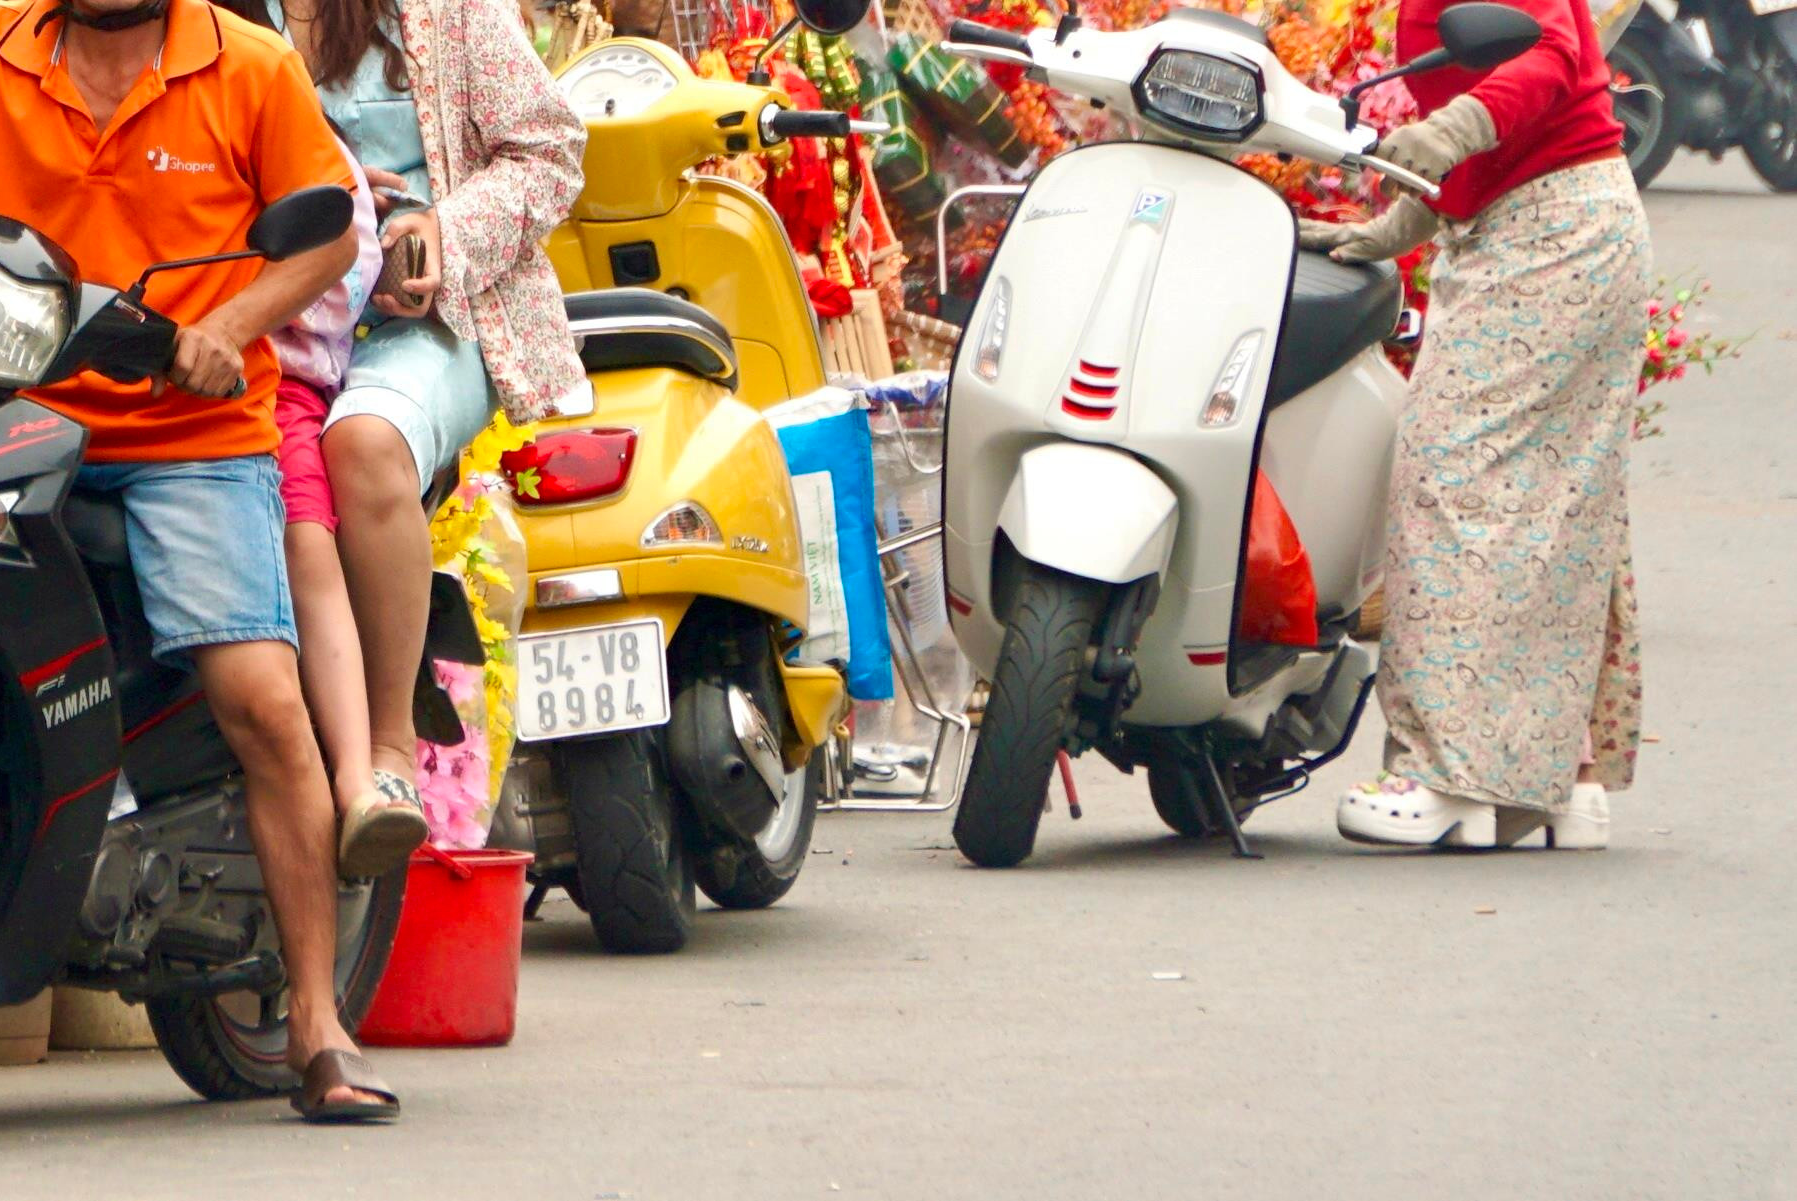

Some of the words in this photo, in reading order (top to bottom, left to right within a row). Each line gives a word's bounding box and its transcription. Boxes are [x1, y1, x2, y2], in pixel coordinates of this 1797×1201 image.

[169, 156, 216, 174] Shopee
[532, 631, 641, 685] 54-V8
[41, 676, 112, 730] YAMAHA
[537, 678, 645, 732] 8984
